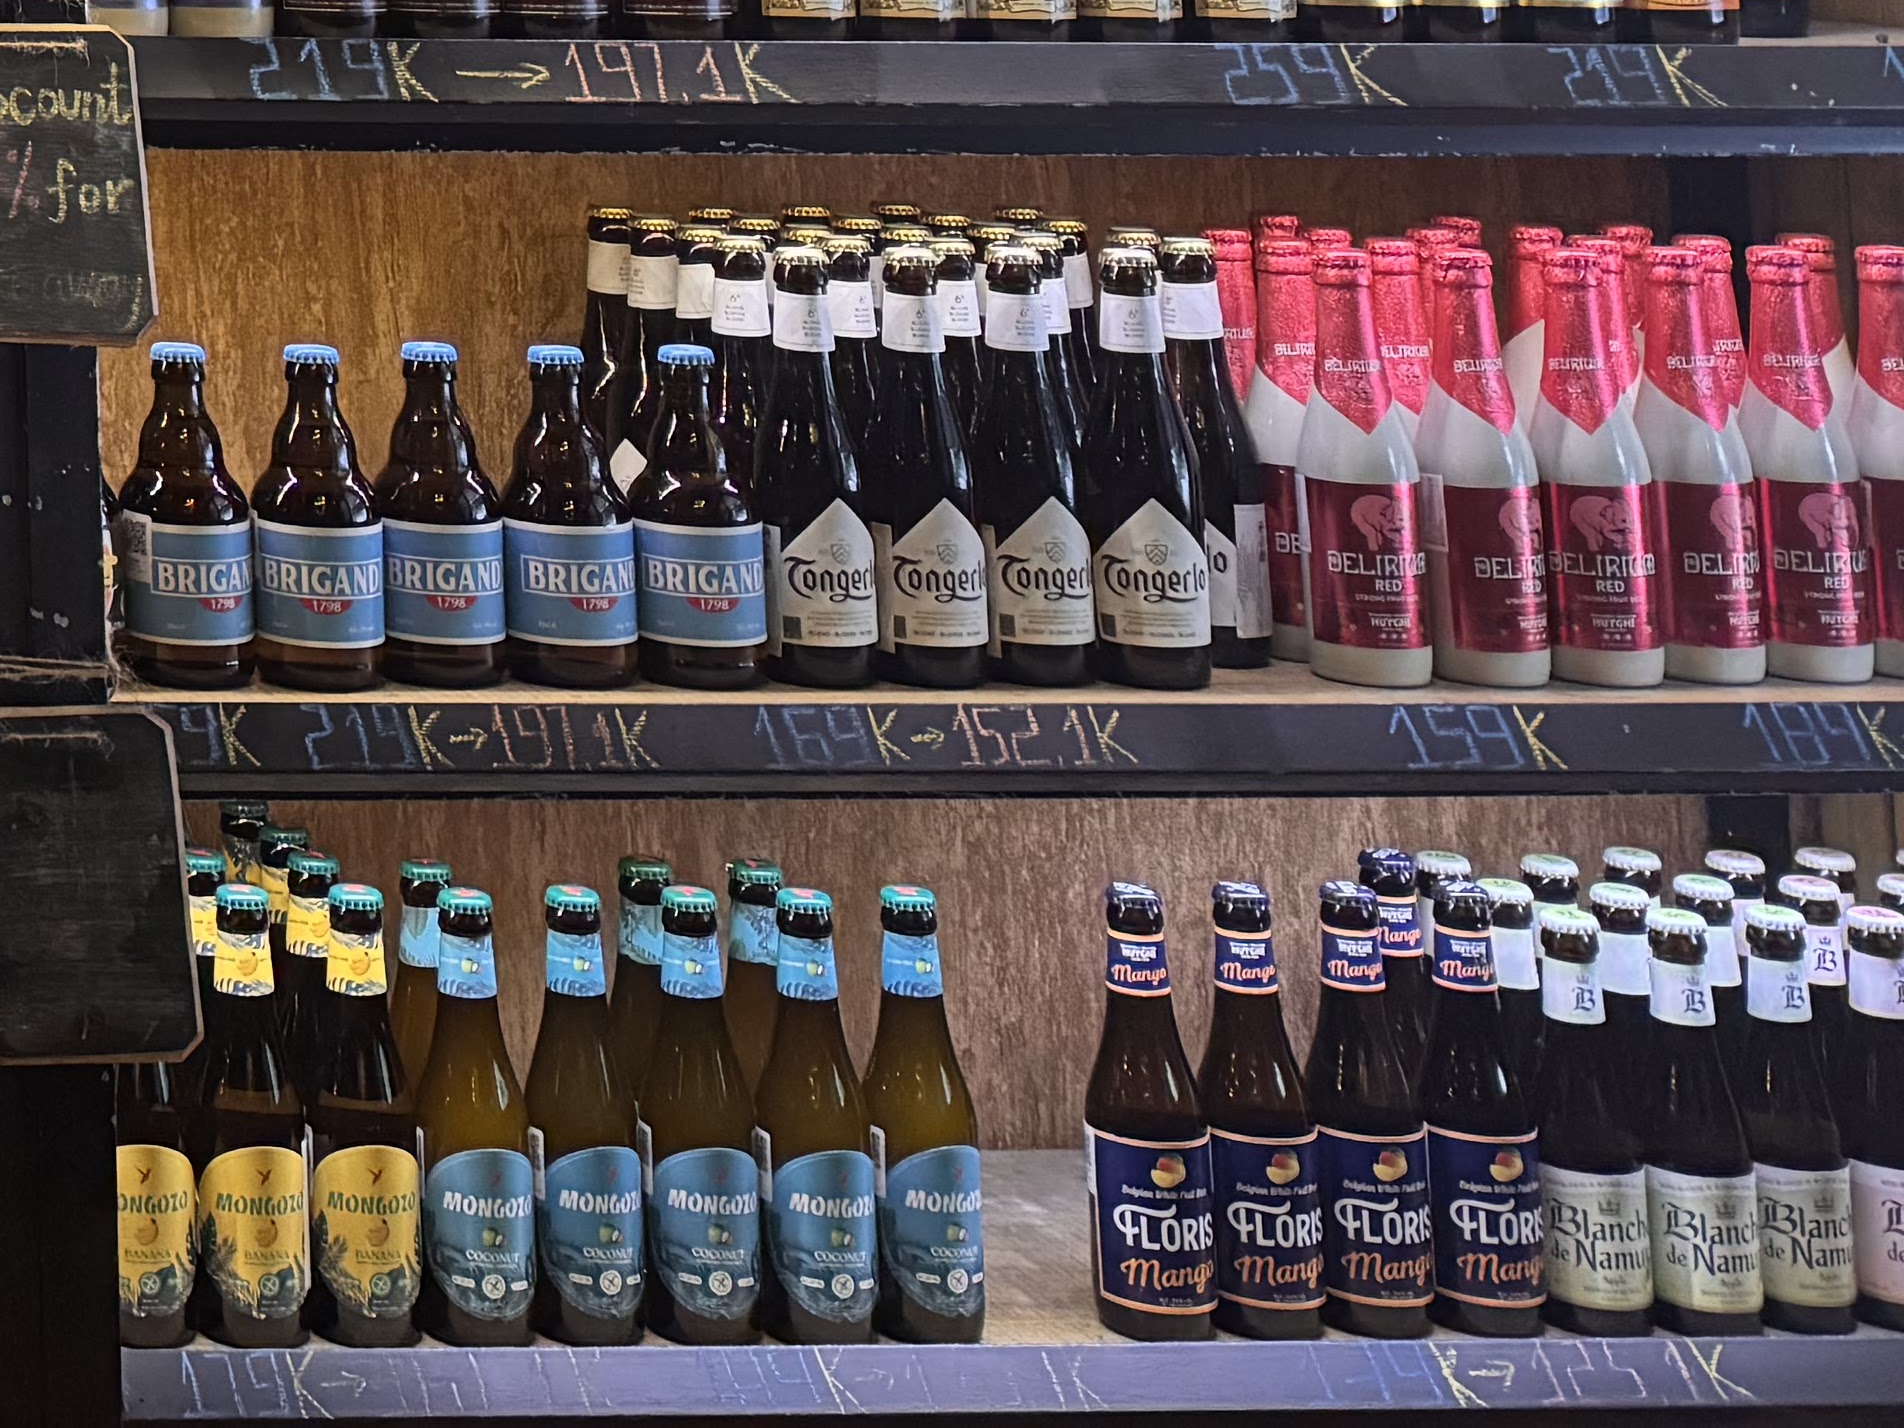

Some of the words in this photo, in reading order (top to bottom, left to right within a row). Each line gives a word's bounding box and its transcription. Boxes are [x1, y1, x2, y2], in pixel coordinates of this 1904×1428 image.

[47, 160, 135, 223] for
[264, 562, 380, 594] BRIGAND
[1101, 554, 1206, 603] Tongerlo
[1375, 579, 1402, 593] RED
[312, 600, 342, 614] 1798
[326, 1190, 417, 1216] MONGOZO
[442, 1191, 533, 1217] MONGOZO
